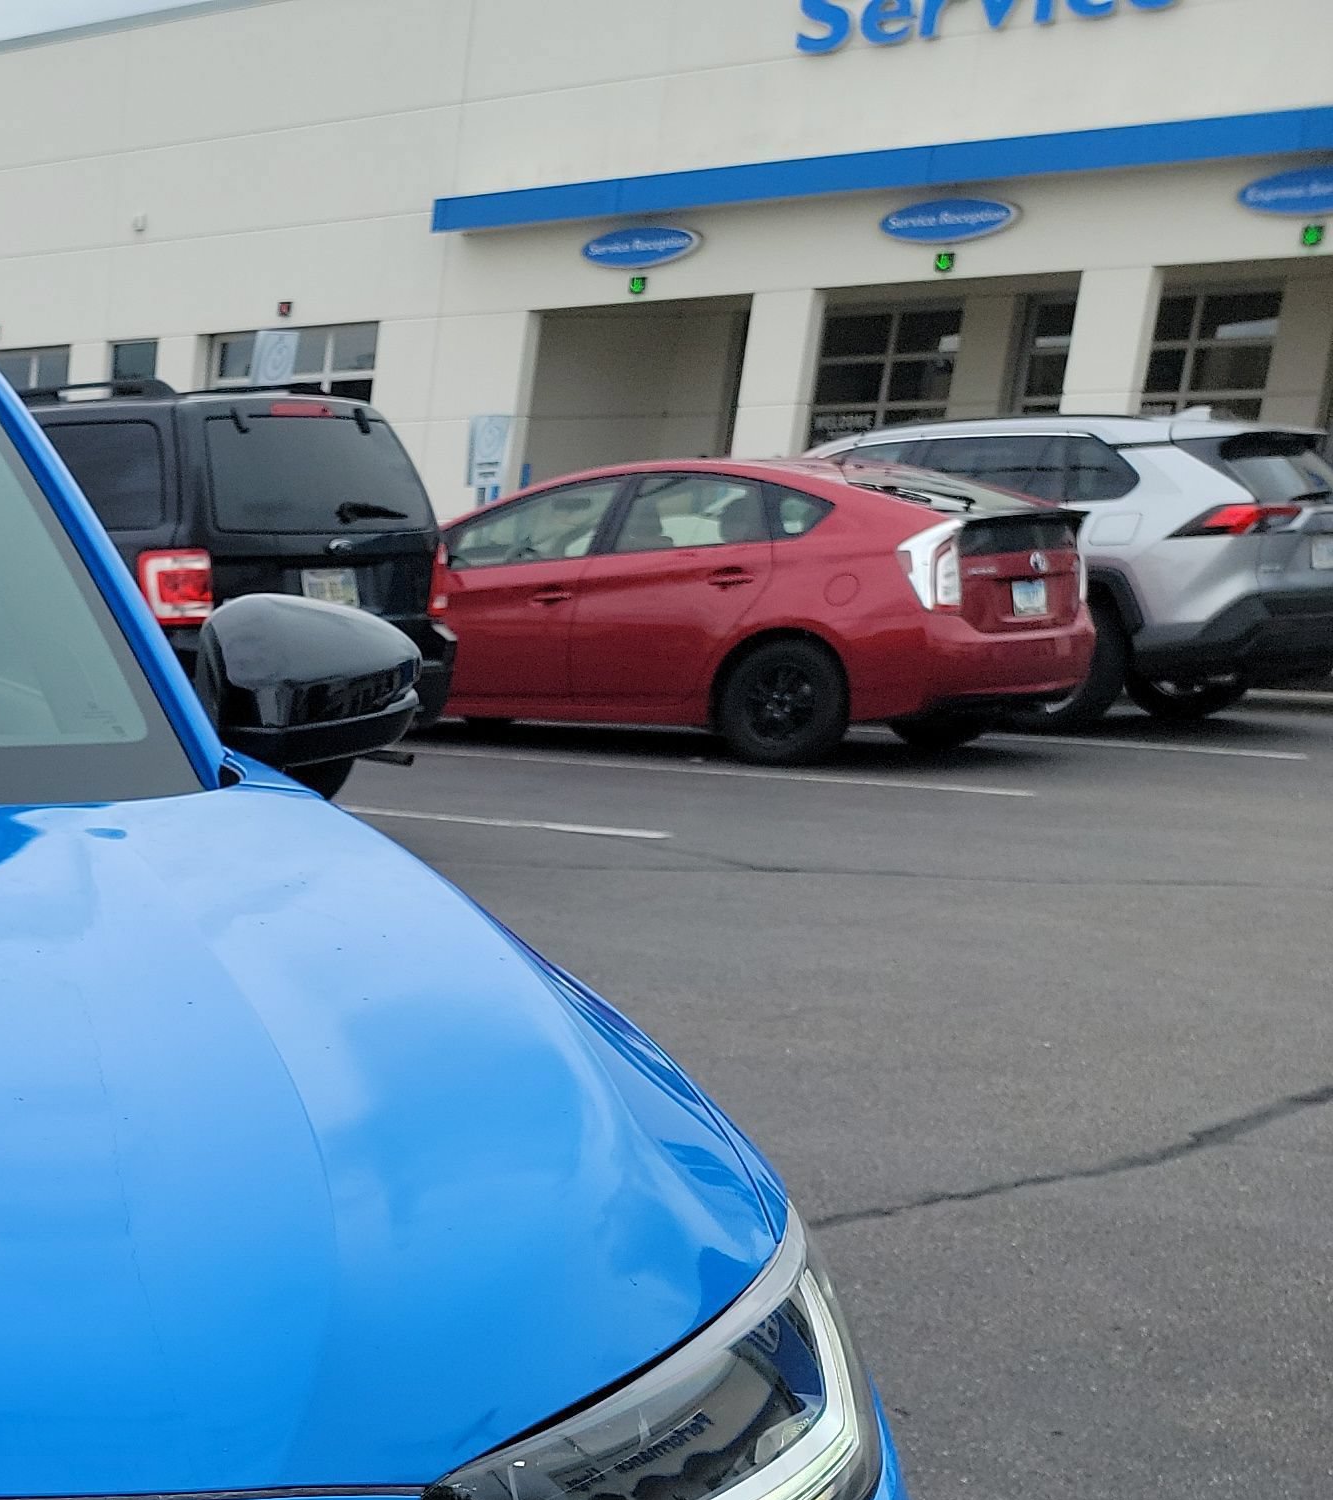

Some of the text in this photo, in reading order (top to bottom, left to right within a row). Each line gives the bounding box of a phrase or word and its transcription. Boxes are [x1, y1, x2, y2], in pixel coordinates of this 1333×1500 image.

[796, 0, 1175, 54] Serv
[888, 209, 1009, 230] Service Reception
